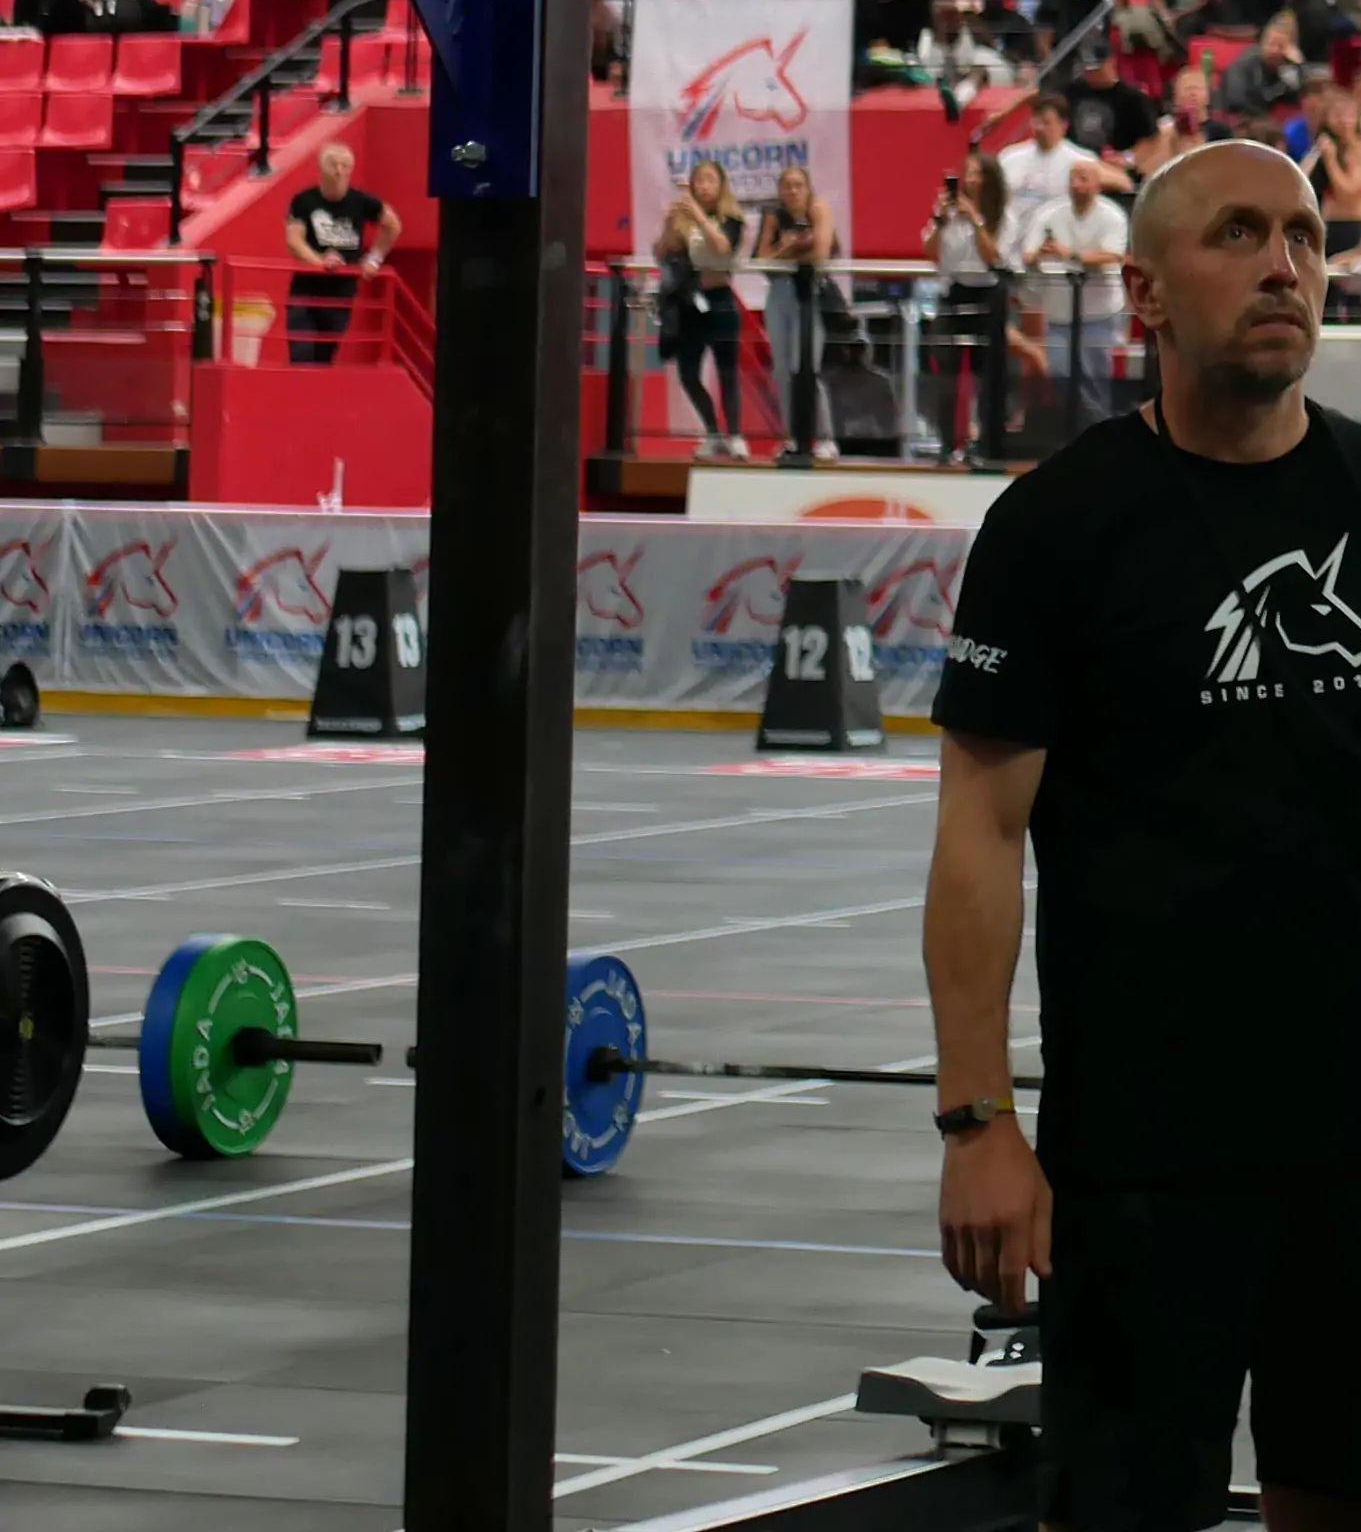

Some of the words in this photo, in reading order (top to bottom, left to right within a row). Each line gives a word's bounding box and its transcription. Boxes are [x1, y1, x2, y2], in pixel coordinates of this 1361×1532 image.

[666, 138, 810, 175] UNICORN
[335, 614, 379, 669] 13
[783, 625, 829, 682] 12
[1200, 682, 1286, 705] SINCE
